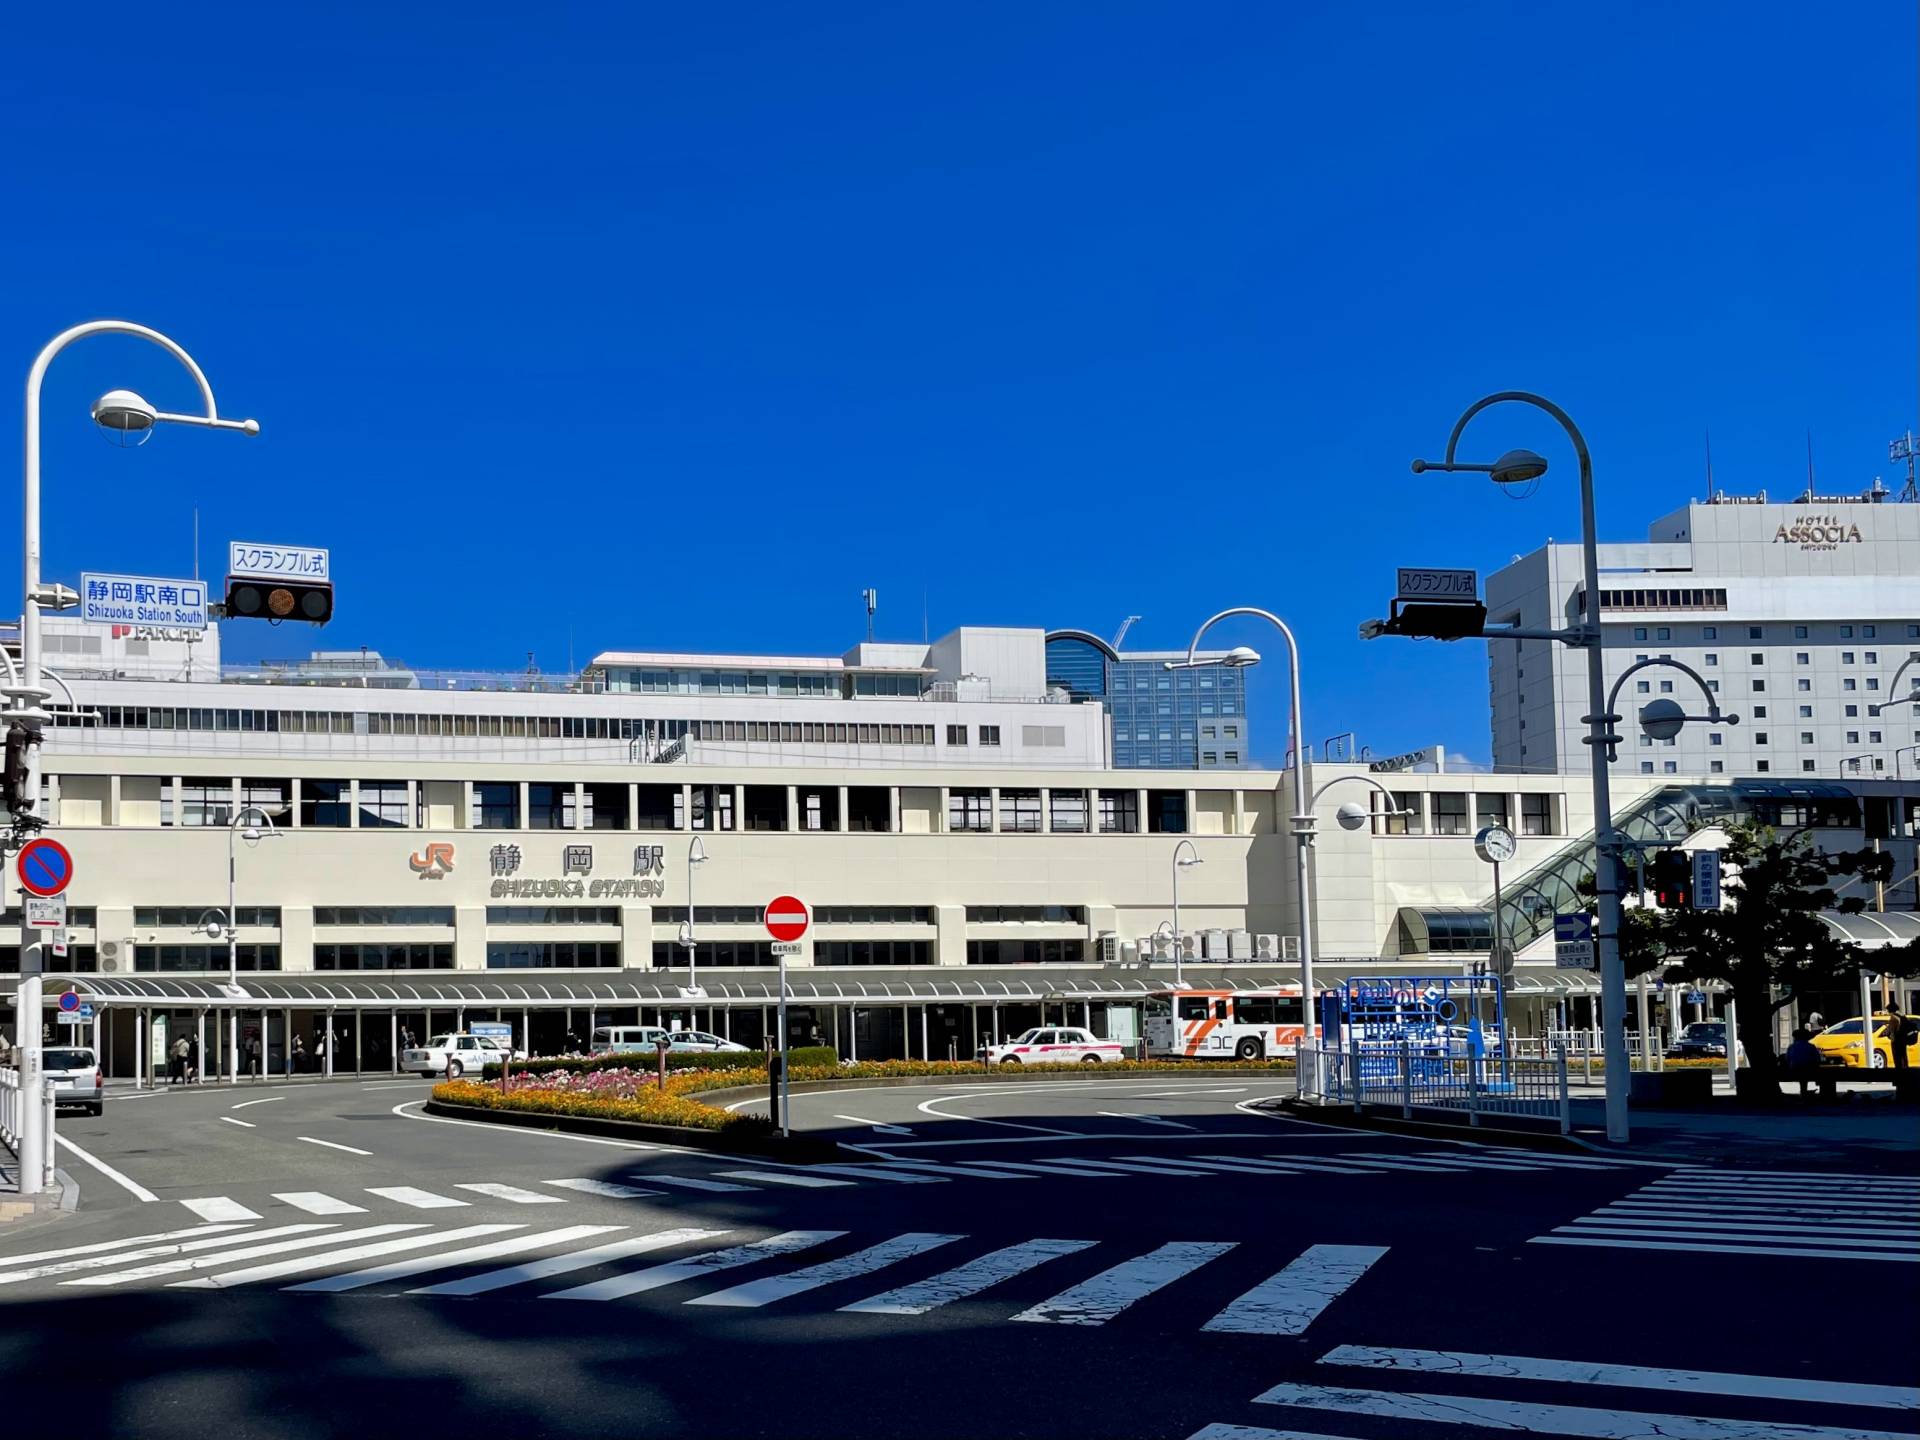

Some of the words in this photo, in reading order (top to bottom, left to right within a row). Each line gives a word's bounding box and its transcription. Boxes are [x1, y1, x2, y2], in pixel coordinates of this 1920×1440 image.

[1796, 515, 1838, 525] HOTEL
[1772, 523, 1862, 543] ASSOCIA
[236, 548, 323, 574] スクランブル式
[1402, 573, 1472, 592] スクランブル式
[87, 580, 200, 606] 静岡駅南口
[87, 603, 133, 619] Shizuoka
[137, 606, 171, 621] Station
[175, 609, 202, 623] South
[410, 843, 455, 870] JR
[491, 844, 663, 872] 静岡駅
[492, 879, 584, 896] SHIZUOKA
[589, 879, 663, 896] STATION
